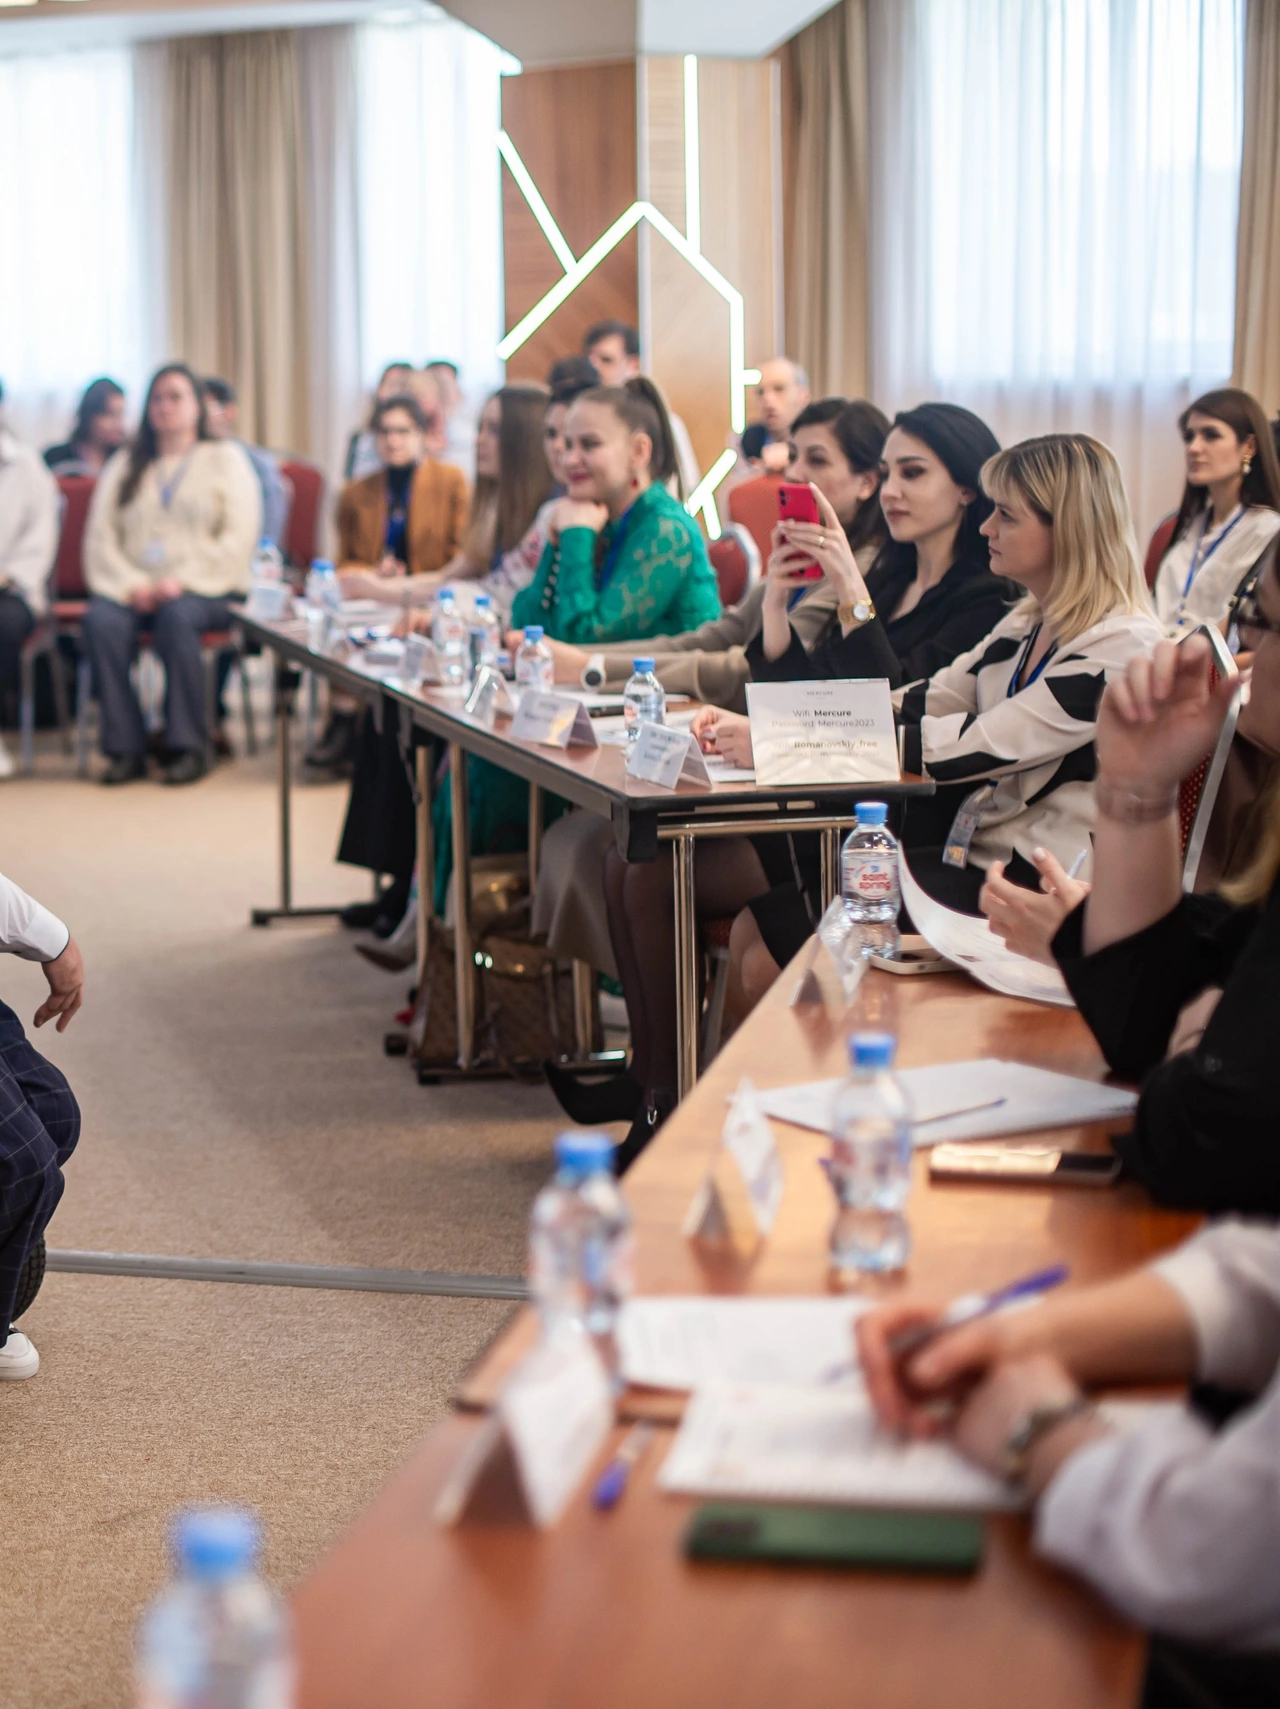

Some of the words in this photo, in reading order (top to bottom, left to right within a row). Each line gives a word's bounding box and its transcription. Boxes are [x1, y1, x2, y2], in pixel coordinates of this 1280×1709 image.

[814, 709, 852, 718] Mercure
[862, 872, 888, 881] saint
[859, 881, 891, 891] spring
